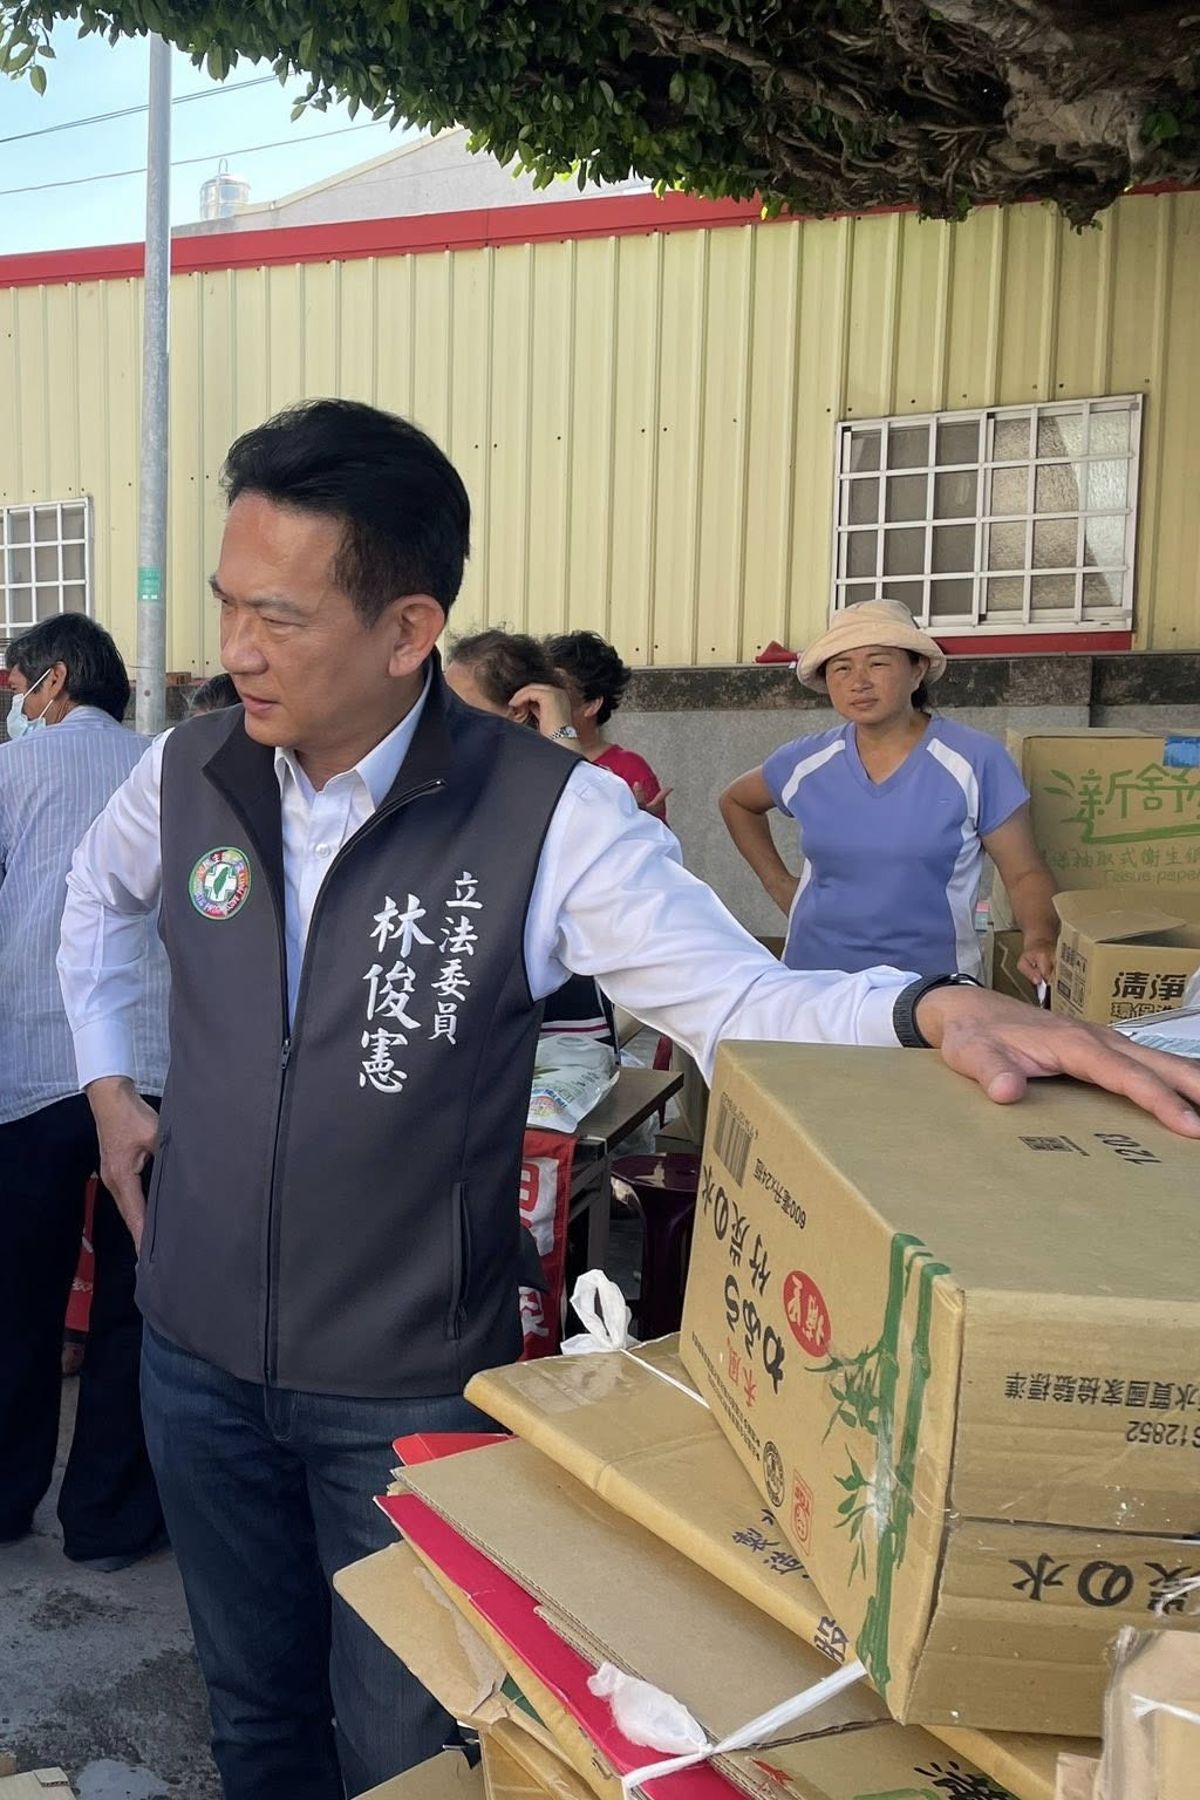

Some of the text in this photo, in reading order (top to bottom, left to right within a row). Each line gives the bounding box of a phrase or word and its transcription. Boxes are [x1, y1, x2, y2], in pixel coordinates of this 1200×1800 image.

[427, 871, 484, 1045] 立法委員
[358, 893, 436, 1094] 林俊憲
[1112, 971, 1187, 1001] 清淨
[1093, 1132, 1163, 1166] 1203
[1004, 1372, 1200, 1411] 水質國家檢驗標準
